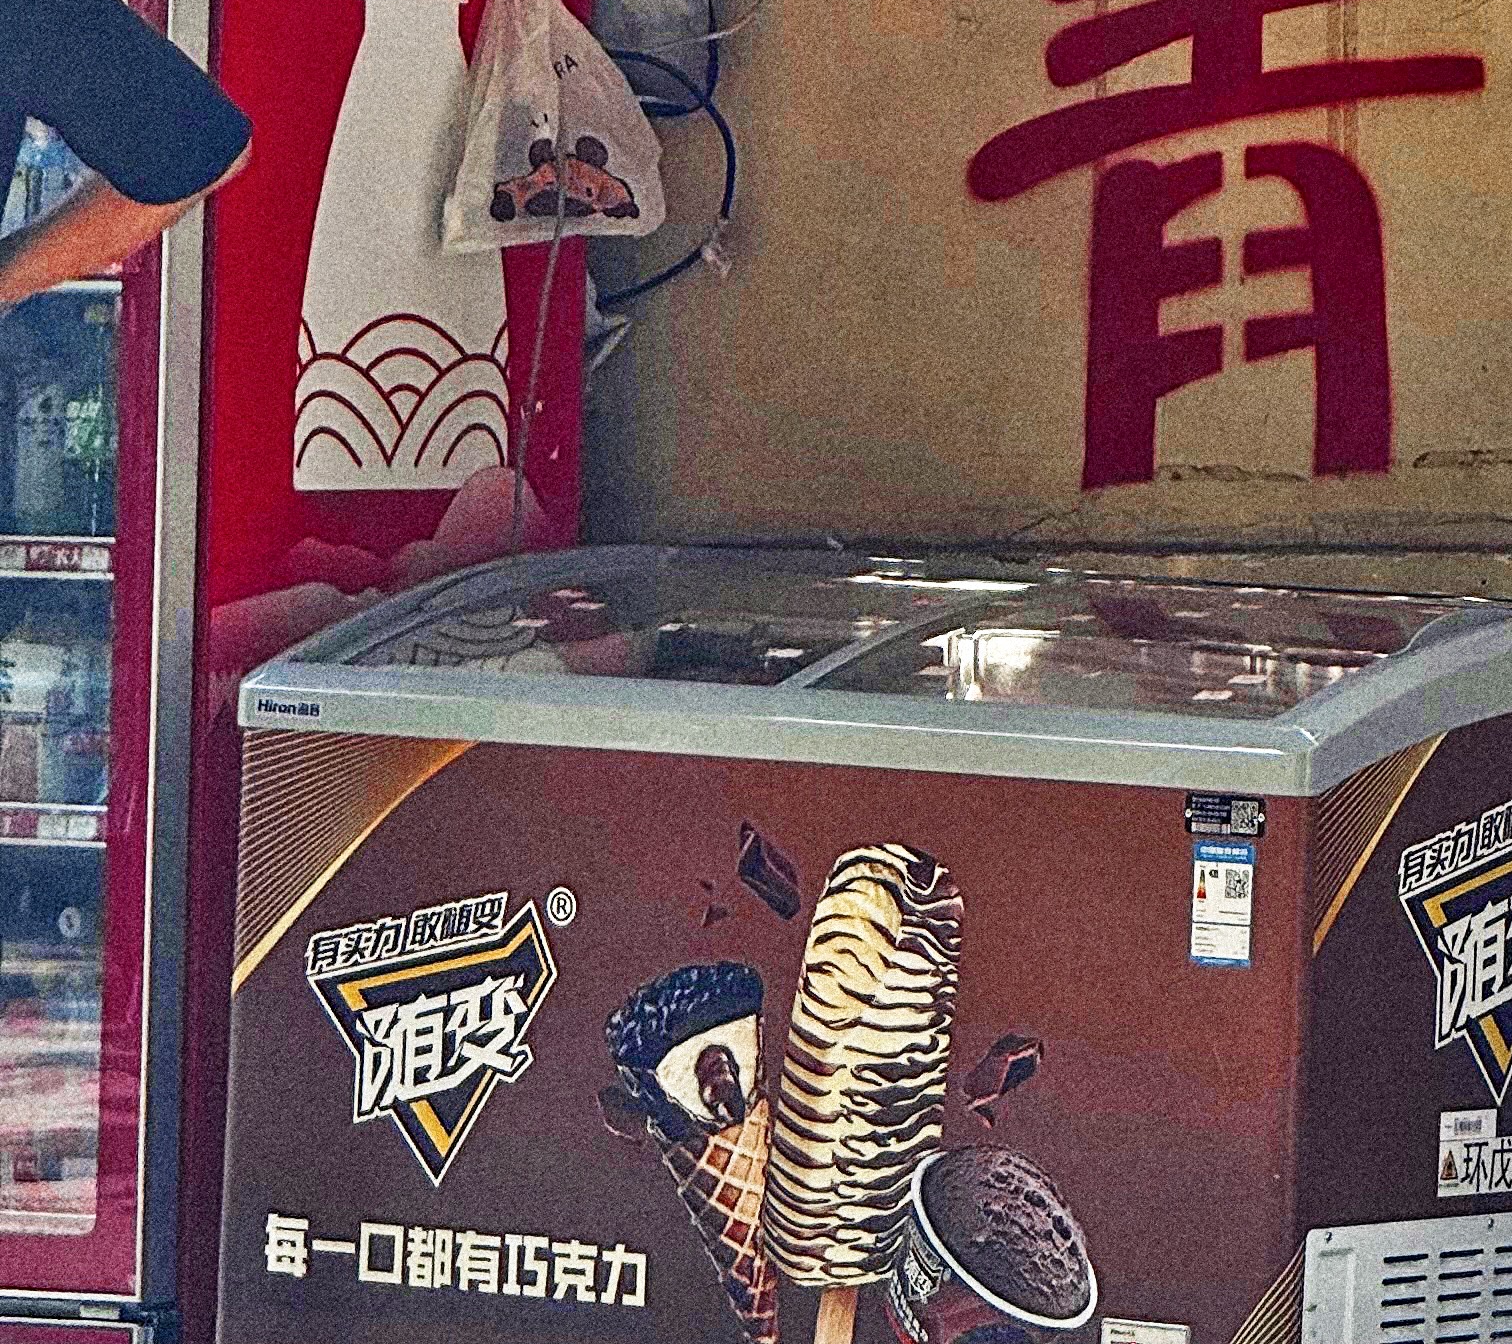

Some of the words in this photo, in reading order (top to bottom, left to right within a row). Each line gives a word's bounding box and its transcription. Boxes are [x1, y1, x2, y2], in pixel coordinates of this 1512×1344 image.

[311, 918, 403, 970] 有实力
[354, 973, 528, 1114] 随变
[264, 1212, 648, 1308] 每一口都有巧克力
